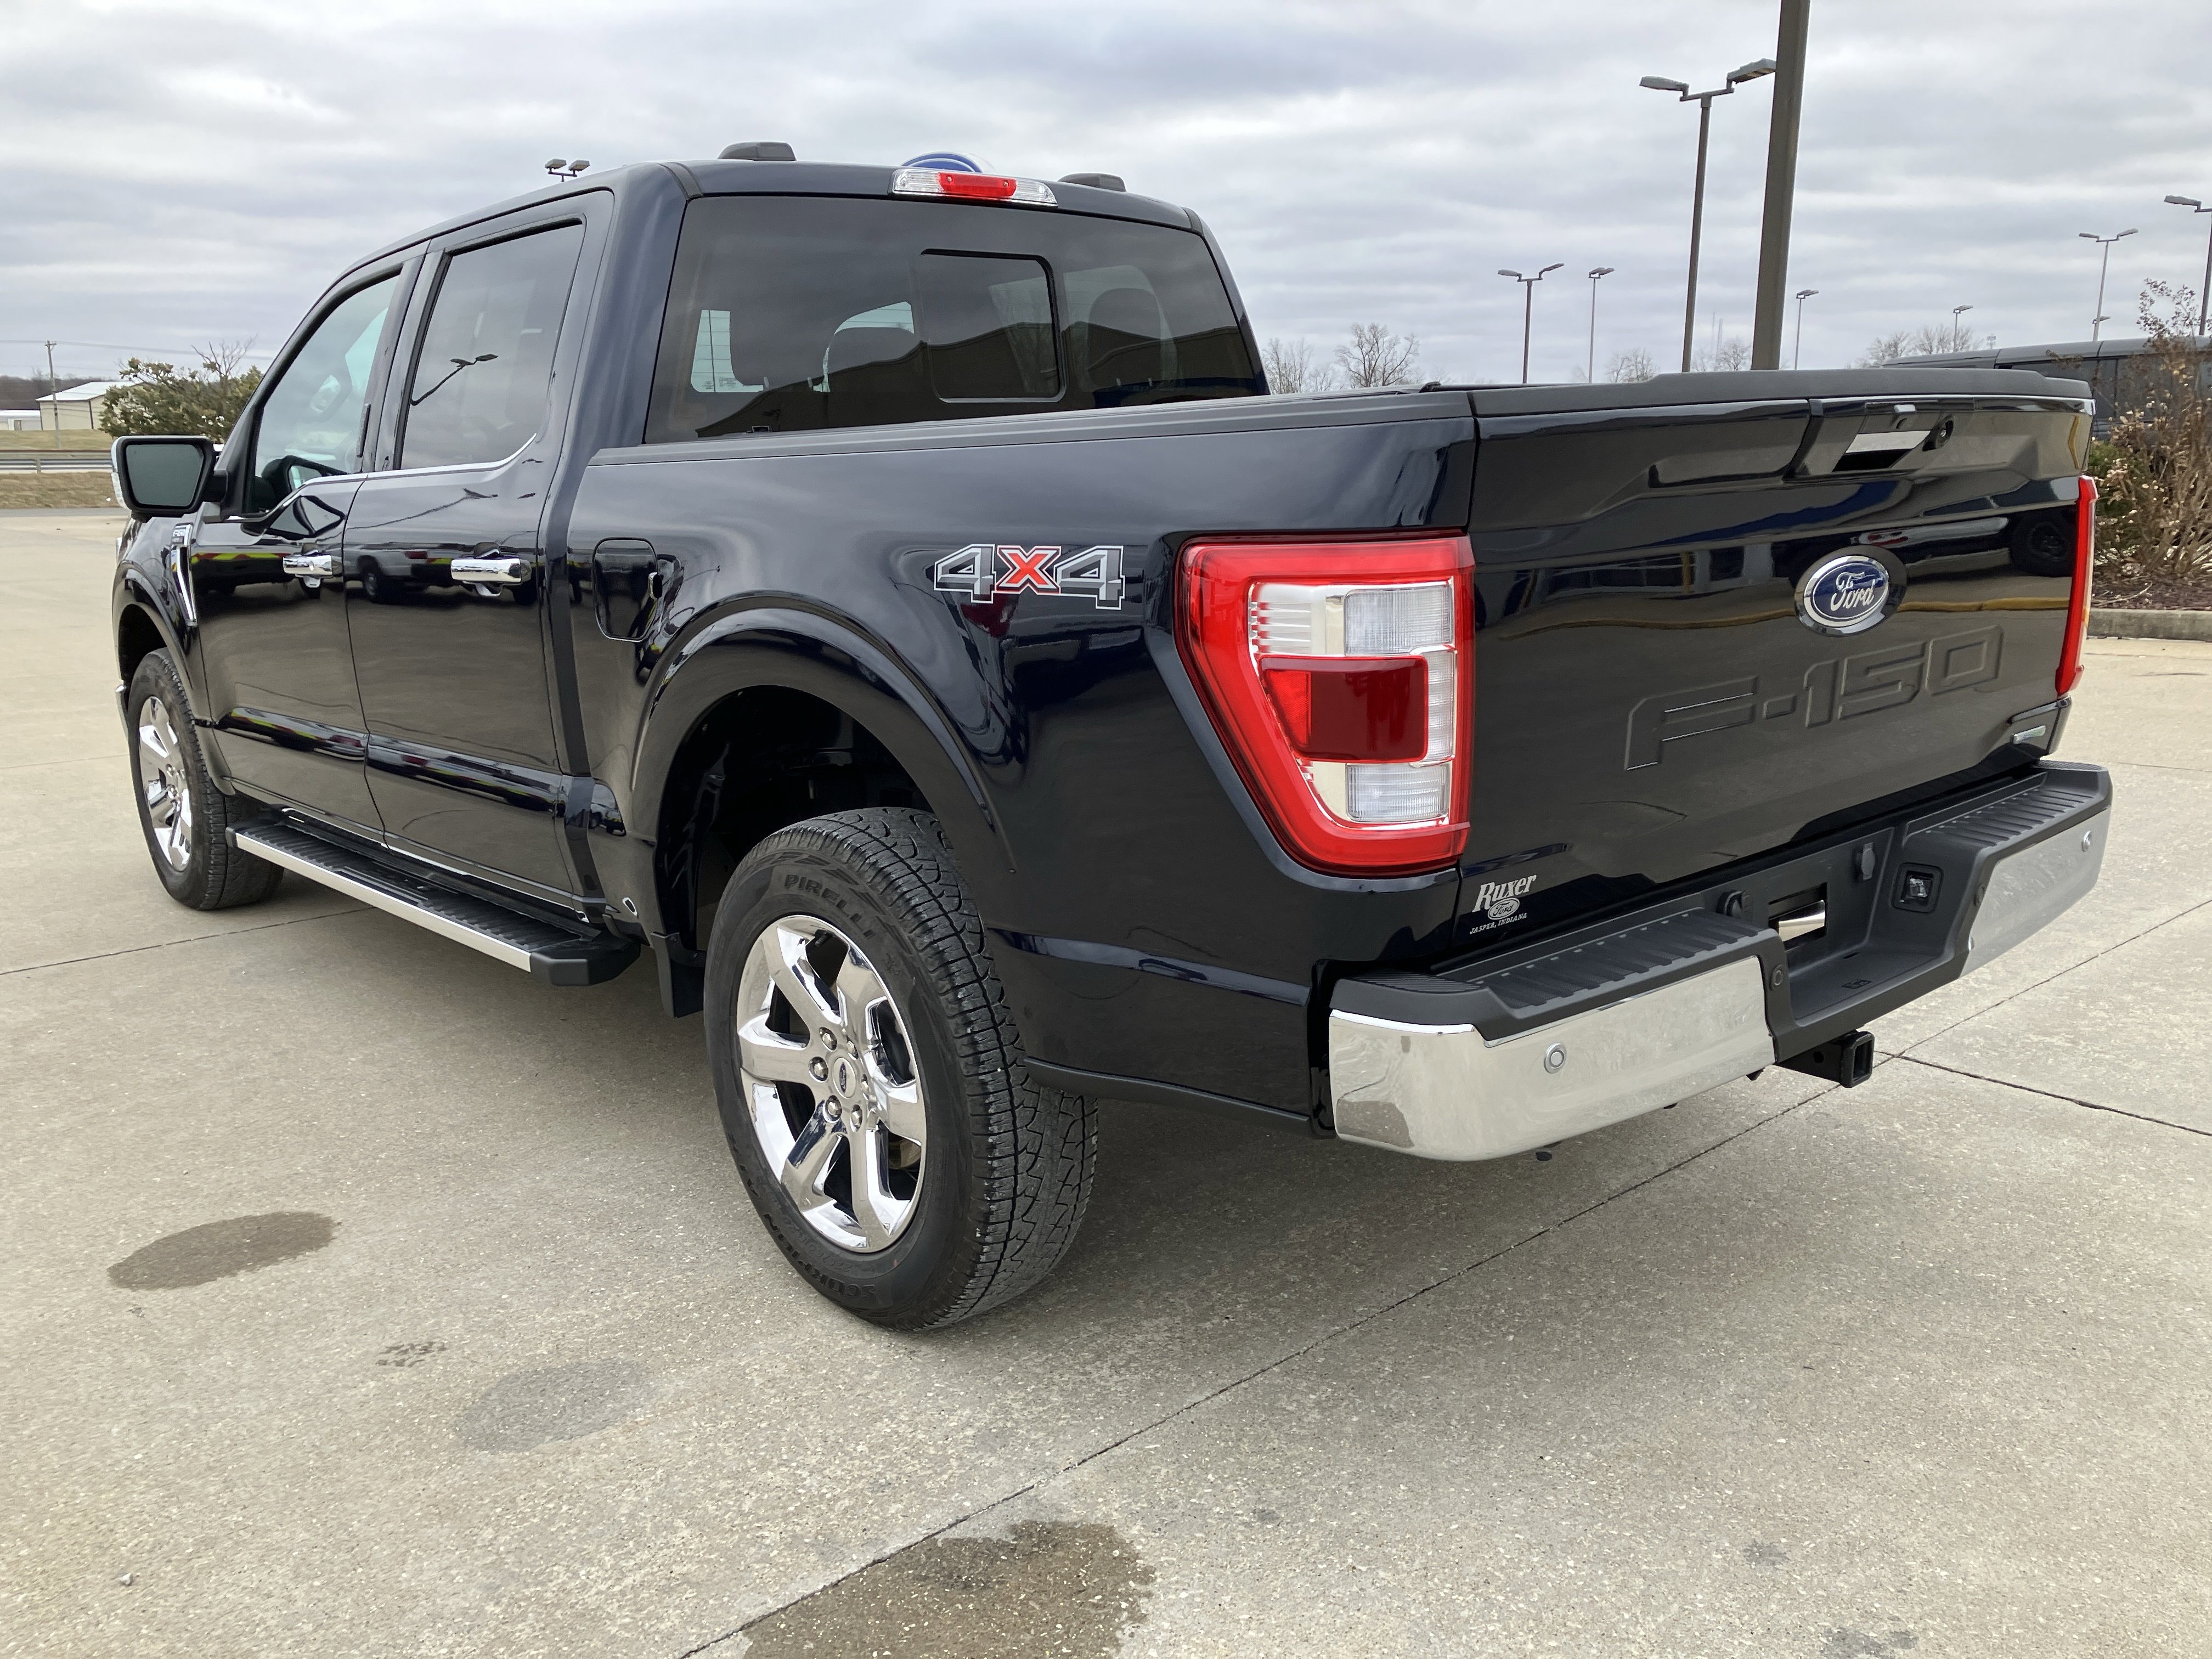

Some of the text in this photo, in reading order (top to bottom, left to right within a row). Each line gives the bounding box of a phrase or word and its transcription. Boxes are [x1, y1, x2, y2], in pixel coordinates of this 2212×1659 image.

[1830, 572, 1876, 612] Ford
[1624, 625, 2004, 771] F-150
[783, 873, 876, 939] PIRELLI
[1471, 874, 1537, 913] Ruxer
[1493, 901, 1515, 916] Ford
[1469, 912, 1527, 935] JASPER, INDIANA
